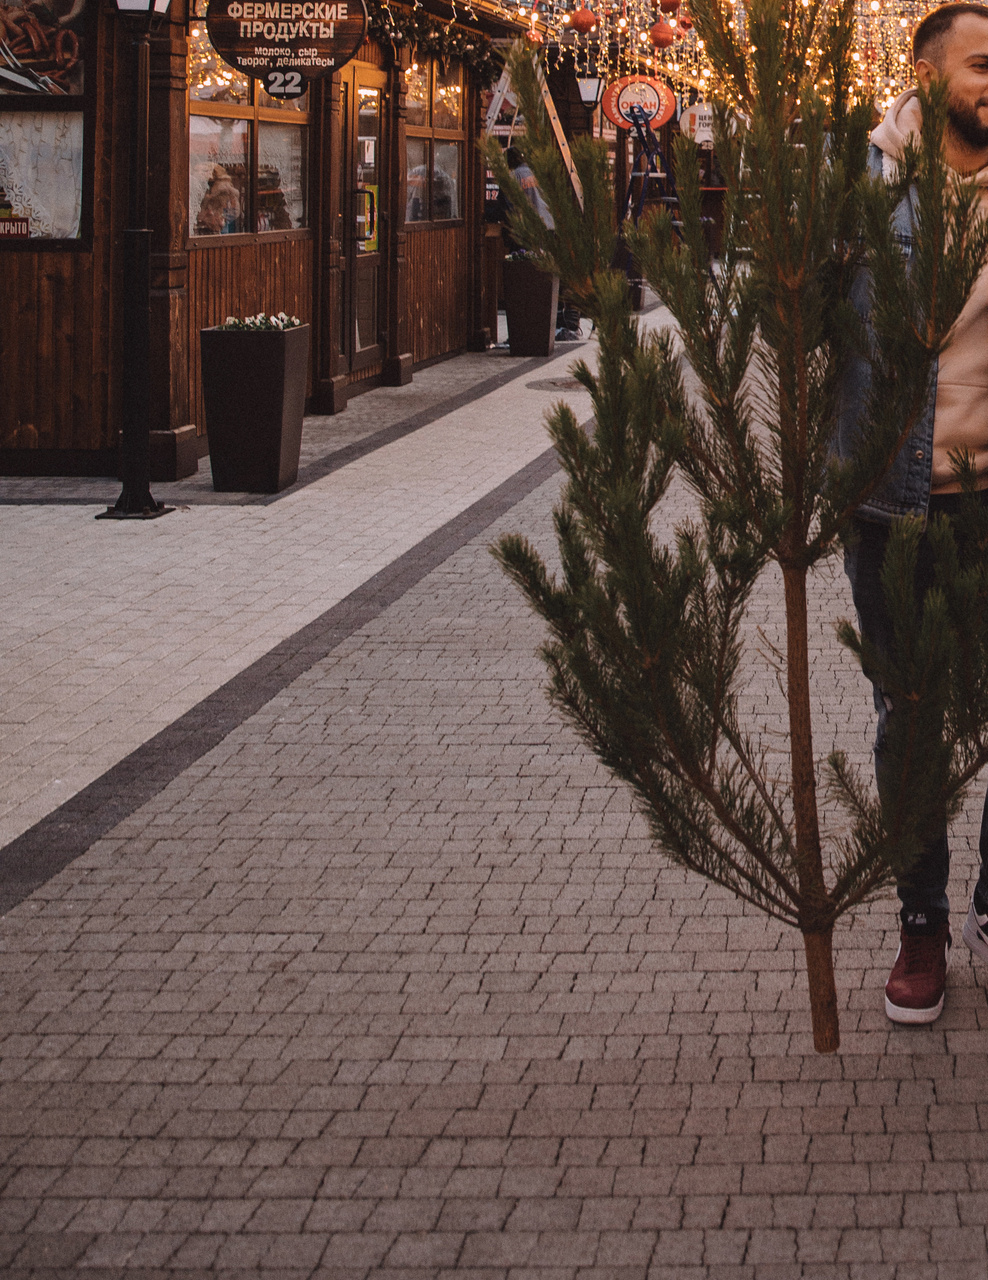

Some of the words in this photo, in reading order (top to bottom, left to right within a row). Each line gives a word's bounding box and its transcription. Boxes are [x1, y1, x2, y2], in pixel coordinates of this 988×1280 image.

[227, 1, 349, 21] ФЕРМЕРСКИЕ
[239, 21, 335, 42] ПРОДУКТЫ
[276, 56, 335, 68] деликатесы
[298, 47, 318, 59] сыр
[267, 71, 302, 94] 22
